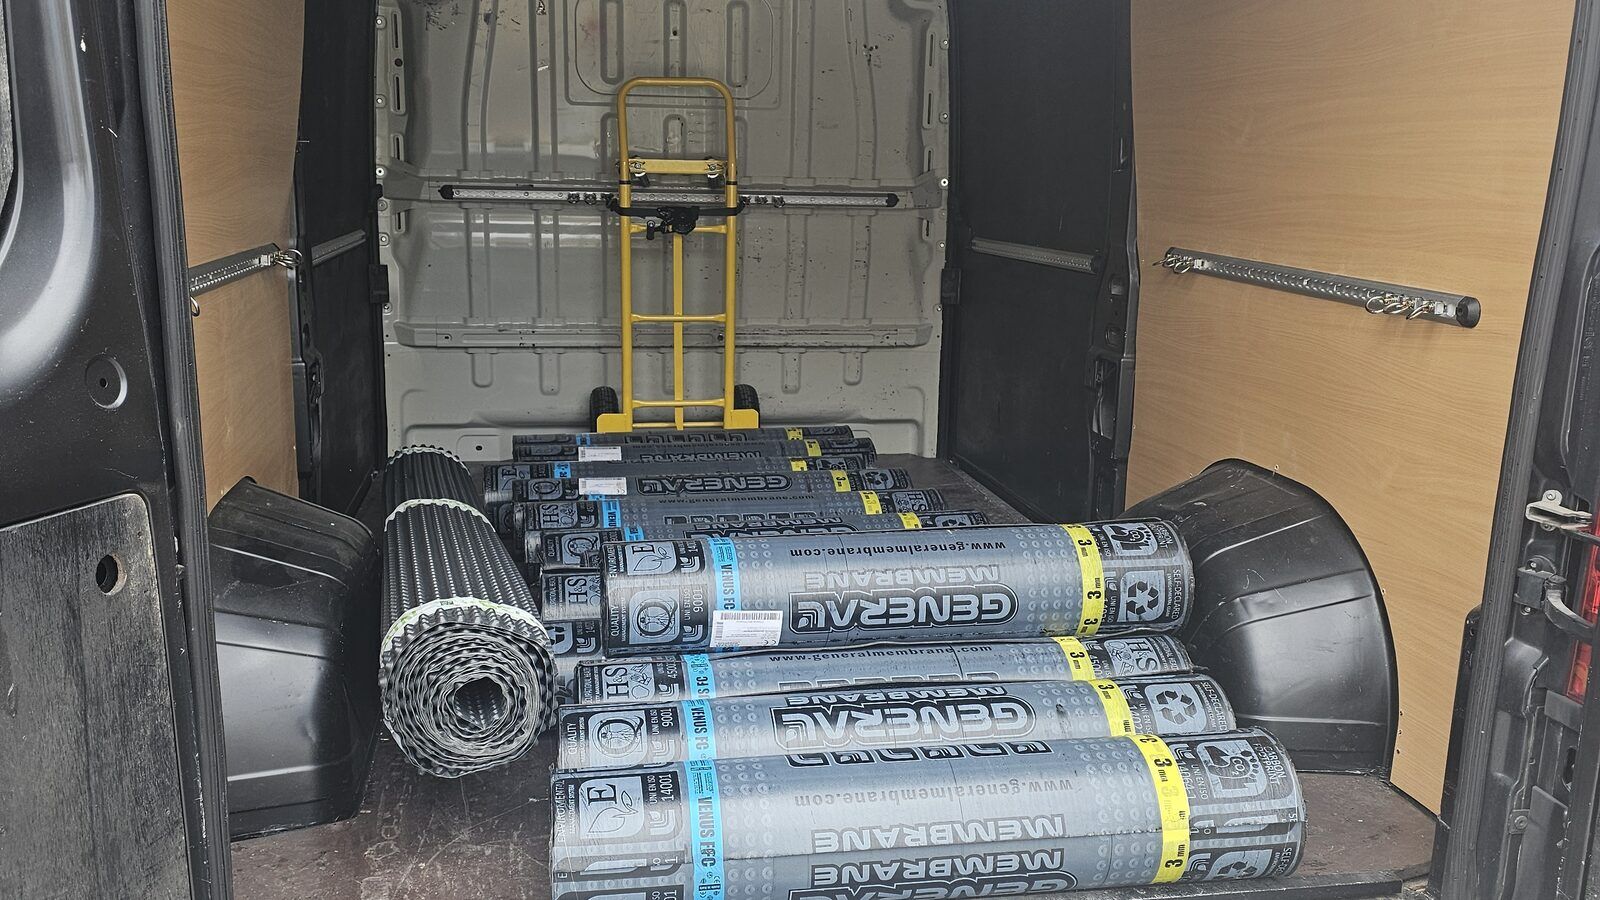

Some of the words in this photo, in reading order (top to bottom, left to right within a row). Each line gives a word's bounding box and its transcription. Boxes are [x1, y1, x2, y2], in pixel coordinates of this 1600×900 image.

[641, 475, 790, 492] GENERAL
[608, 511, 617, 527] VENU
[790, 541, 1007, 557] www.generalmembrane.com
[722, 563, 735, 595] VENUS
[804, 565, 1001, 590] MEMBRANE
[692, 588, 703, 613] 9001
[1087, 590, 1102, 599] 3
[1171, 569, 1182, 620] SELF-DECLARED
[610, 605, 620, 637] QUALITY
[796, 592, 1012, 630] GENERAL
[1084, 618, 1098, 626] 3
[769, 644, 993, 662] www.generalmembrane.com
[1069, 651, 1085, 659] 3
[604, 667, 630, 699] H&S
[787, 686, 1008, 706] MEMBRANE
[1203, 682, 1227, 731] SELF-DECLARED
[661, 708, 673, 727] 9001
[691, 705, 708, 734] VENUS
[781, 701, 1029, 743] GENERAL
[566, 722, 578, 755] QUALITY
[696, 736, 710, 750] FC
[1154, 758, 1173, 768] 3
[1253, 743, 1281, 786] FOOTPRINT
[1262, 745, 1287, 779] CARBON
[587, 784, 617, 807] E
[649, 784, 657, 792] EN
[649, 792, 658, 804] UNI
[659, 773, 674, 801] 14001
[795, 778, 1073, 808] www.generalmembrane.com
[698, 796, 715, 839] VENUS
[813, 814, 1065, 854] MEMBRANE
[813, 850, 1065, 887] MEMBRANE
[1164, 859, 1184, 869] 3
[1177, 844, 1186, 857] mm
